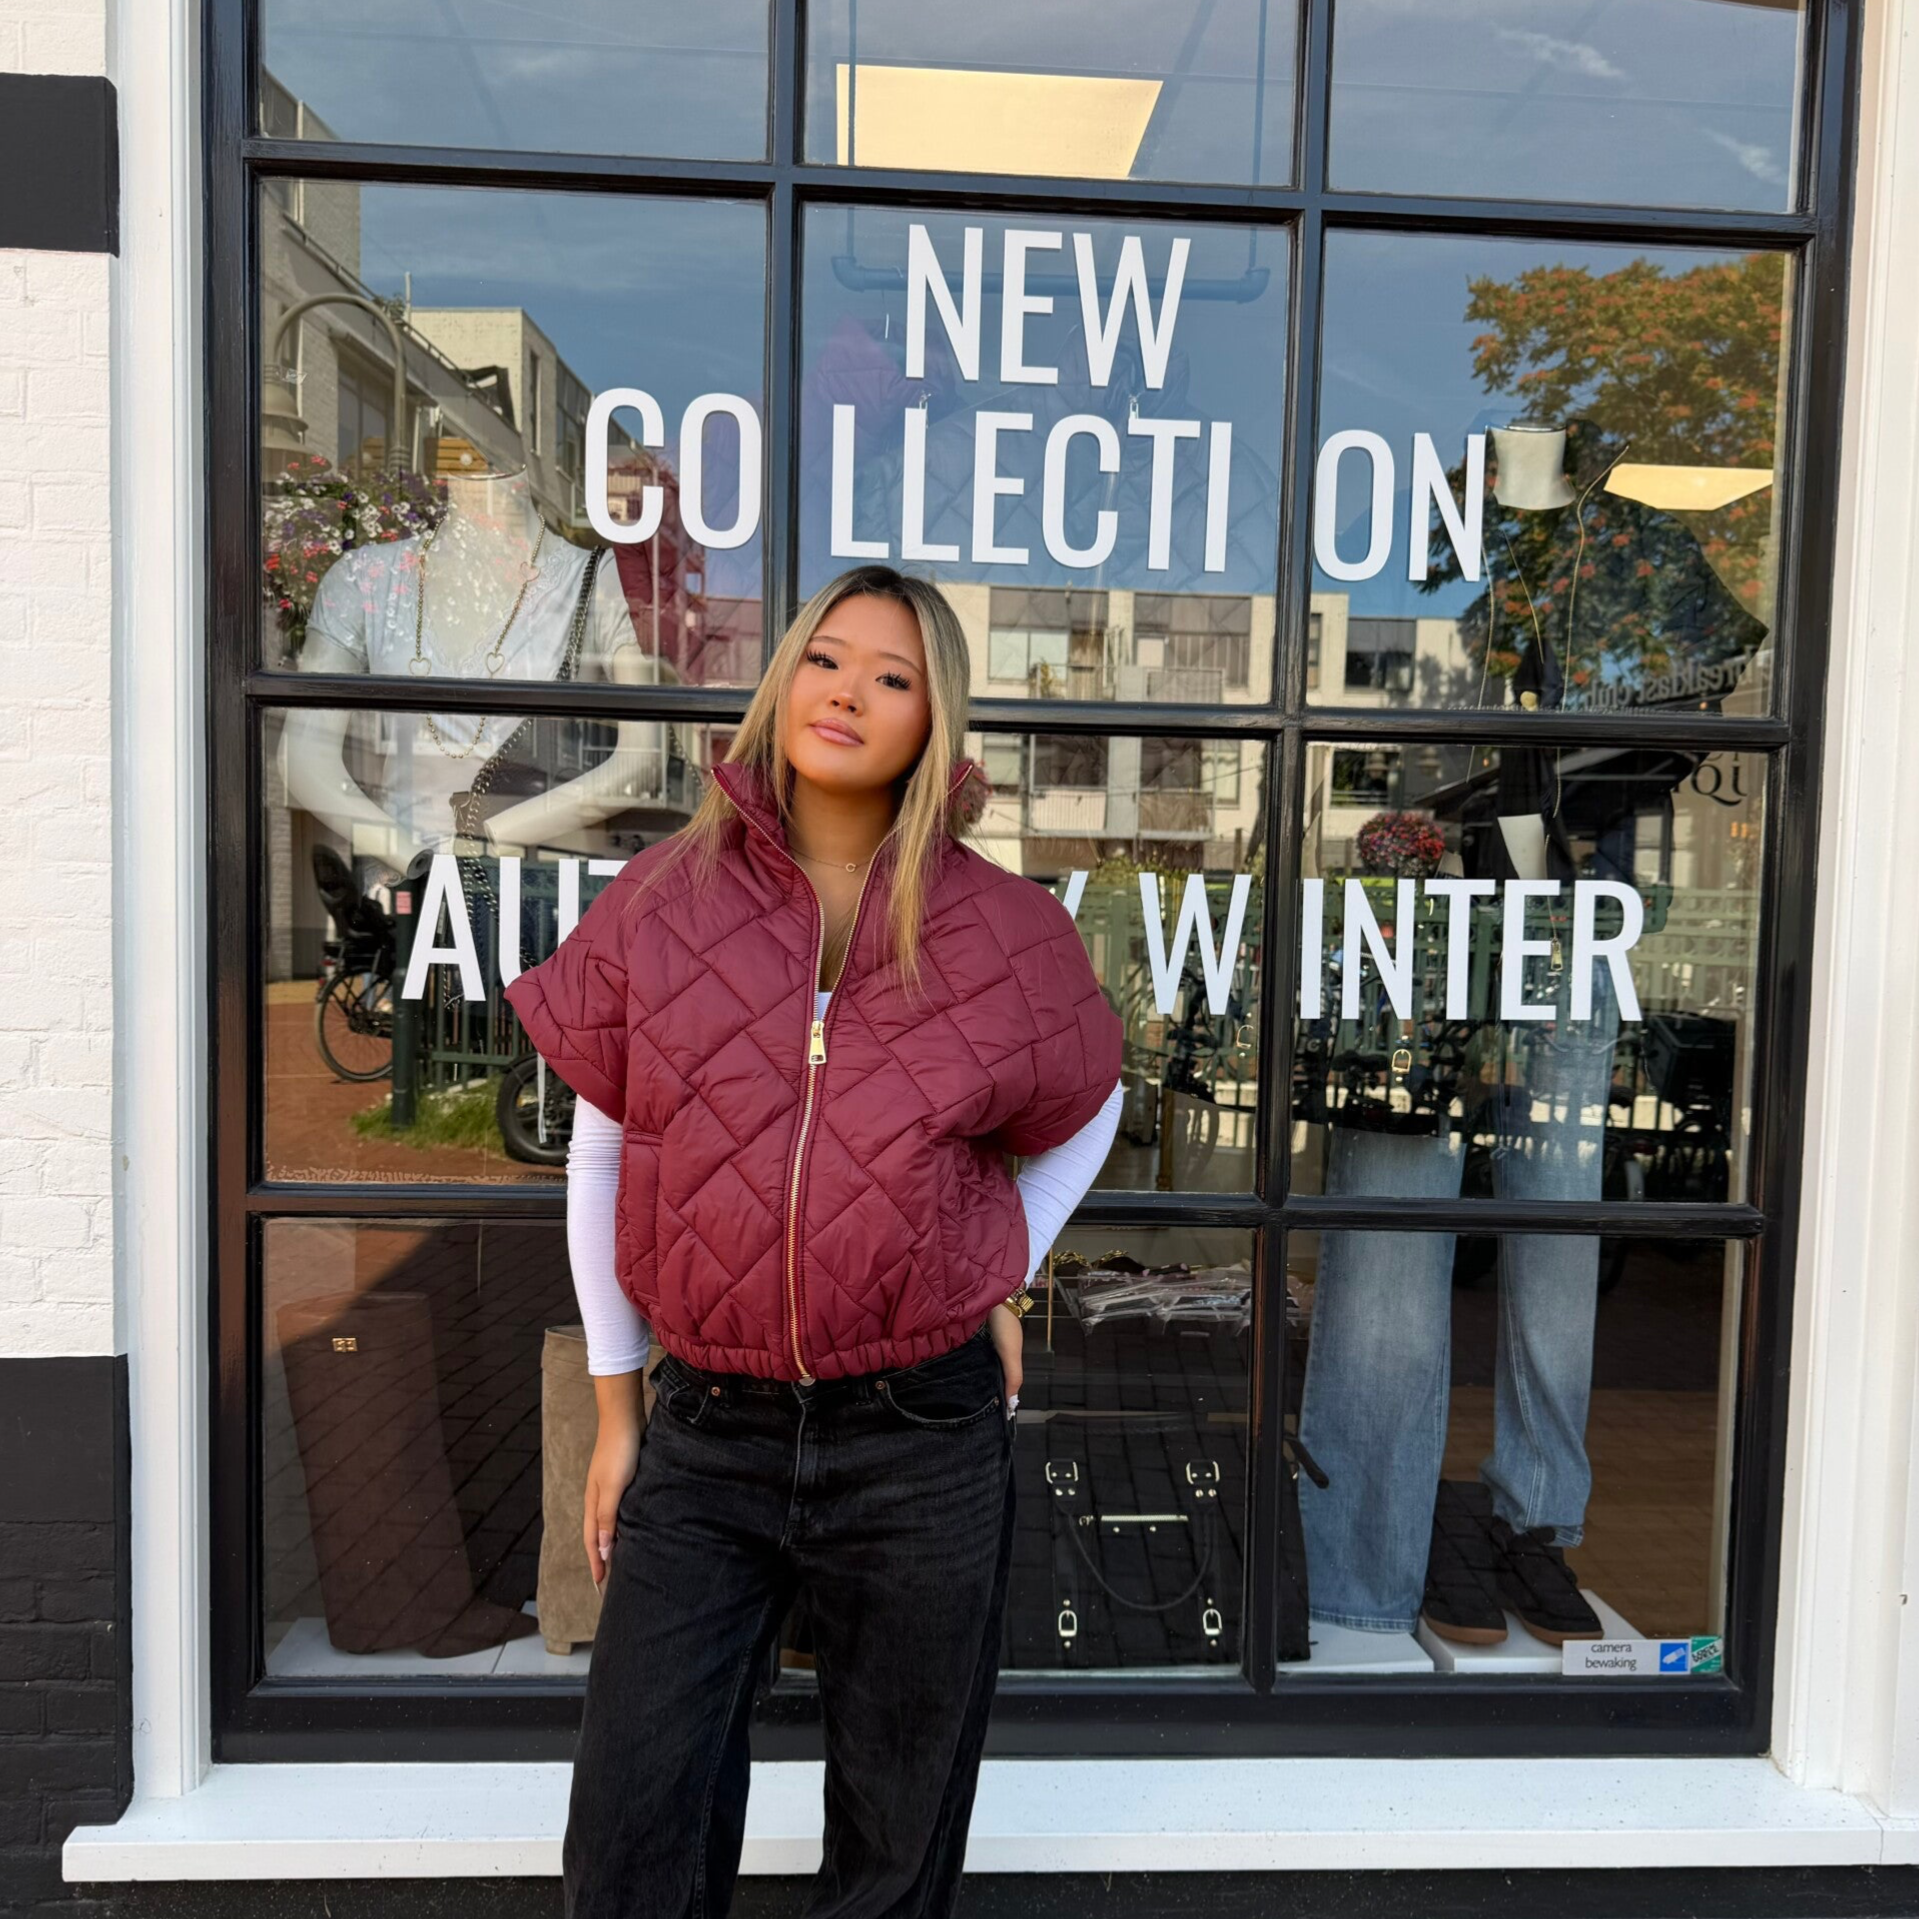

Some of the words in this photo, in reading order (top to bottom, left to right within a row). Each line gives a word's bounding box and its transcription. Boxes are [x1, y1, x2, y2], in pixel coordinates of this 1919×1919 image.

[906, 224, 1191, 389] NEW
[1138, 872, 1644, 1021] WINTER
[1585, 1657, 1637, 1672] bewaking
[1591, 1643, 1632, 1653] camera
